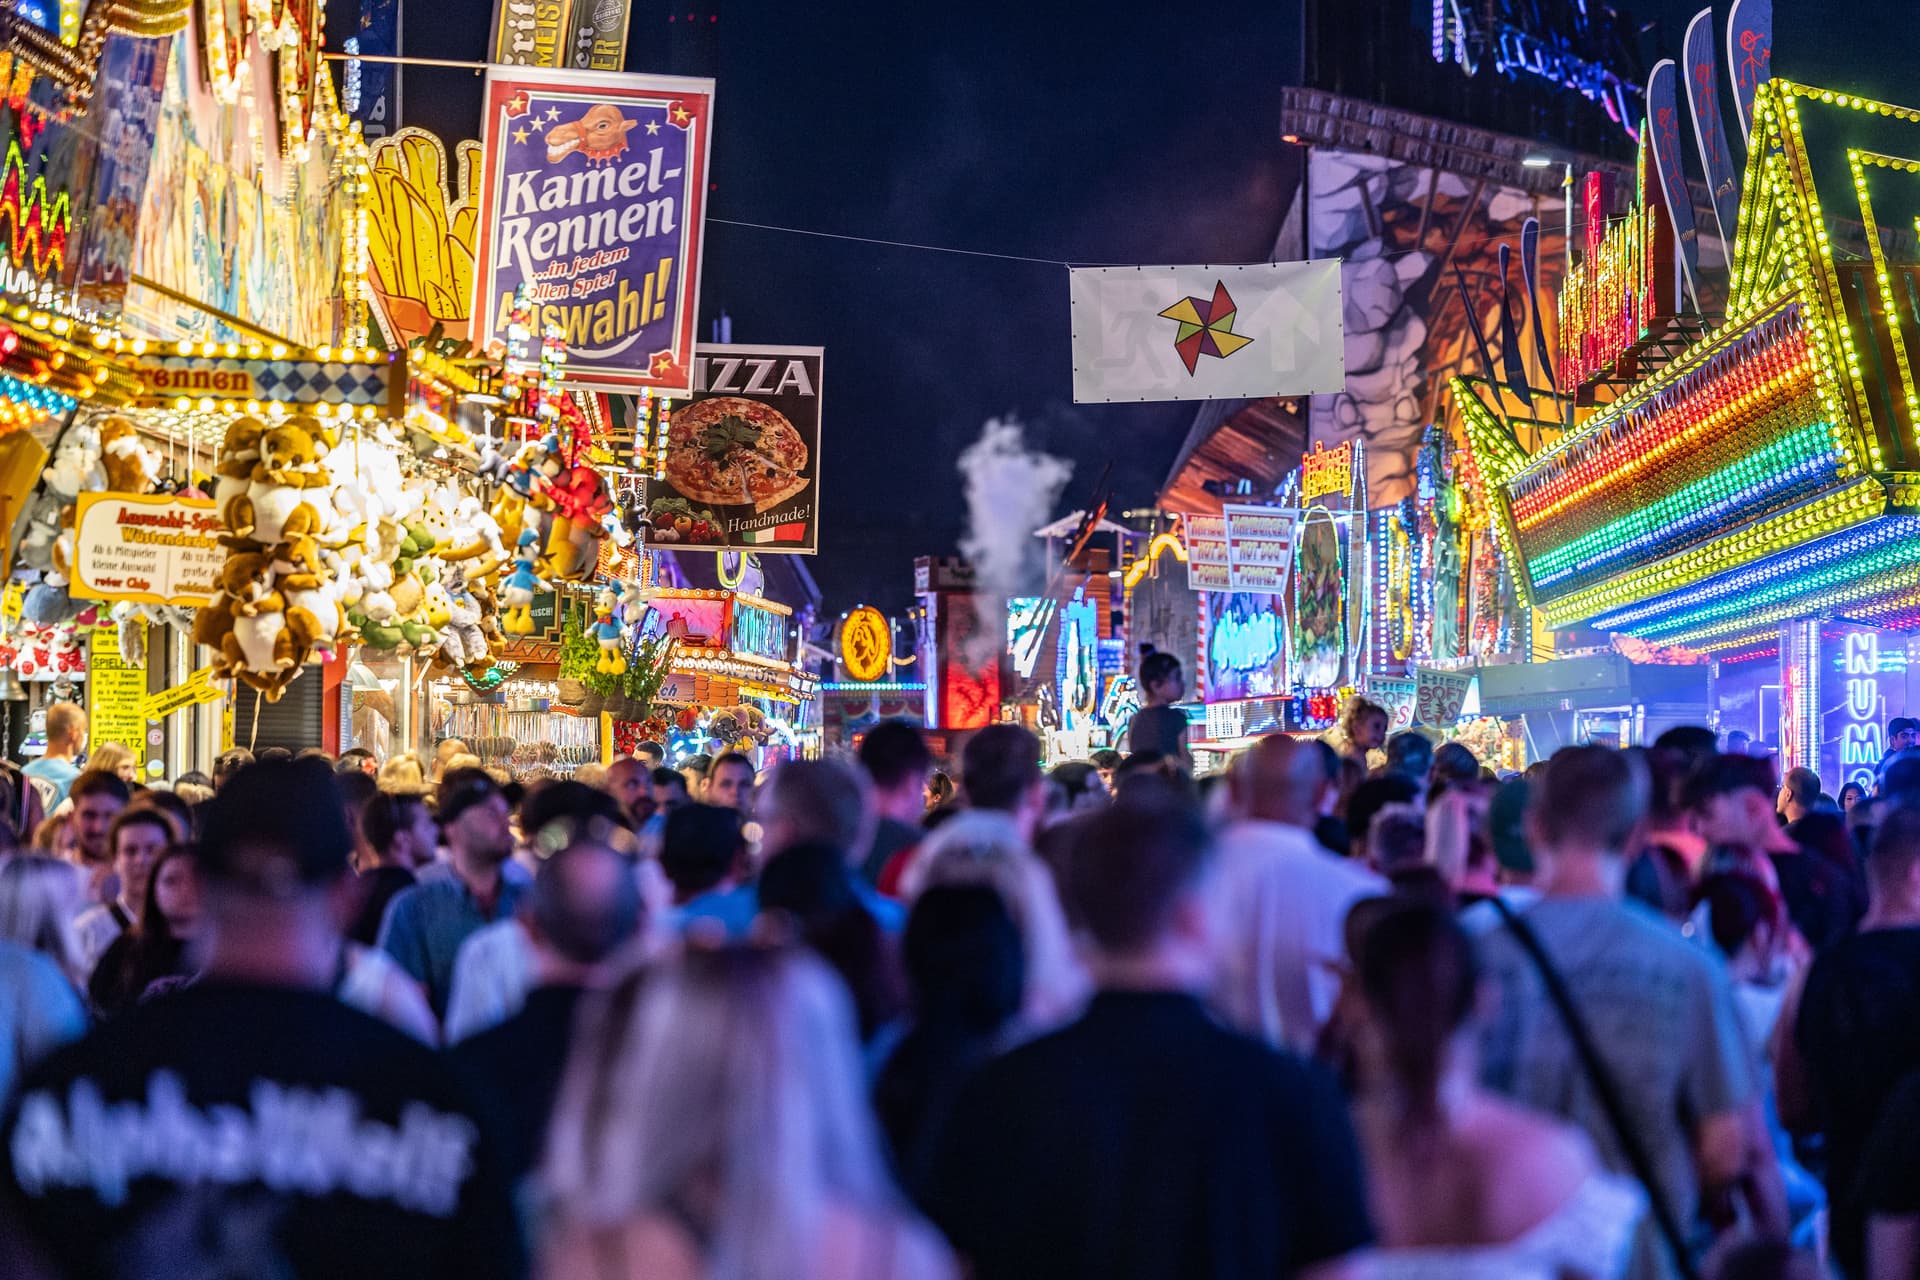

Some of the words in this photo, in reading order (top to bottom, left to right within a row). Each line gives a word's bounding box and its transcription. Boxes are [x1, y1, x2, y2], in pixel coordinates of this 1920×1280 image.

[502, 147, 682, 217] Kamel-
[497, 197, 677, 296] Rennen
[568, 246, 630, 280] jedem
[529, 280, 569, 303] ollen
[571, 268, 617, 300] Spiel
[694, 356, 816, 397] IZZA
[727, 503, 812, 534] Handmade!
[121, 526, 217, 551] Wüstenderby
[94, 576, 122, 588] roter
[126, 576, 150, 591] Chip
[1372, 680, 1415, 691] HIER
[1418, 685, 1464, 702] SOFT
[1421, 673, 1466, 688] HIER
